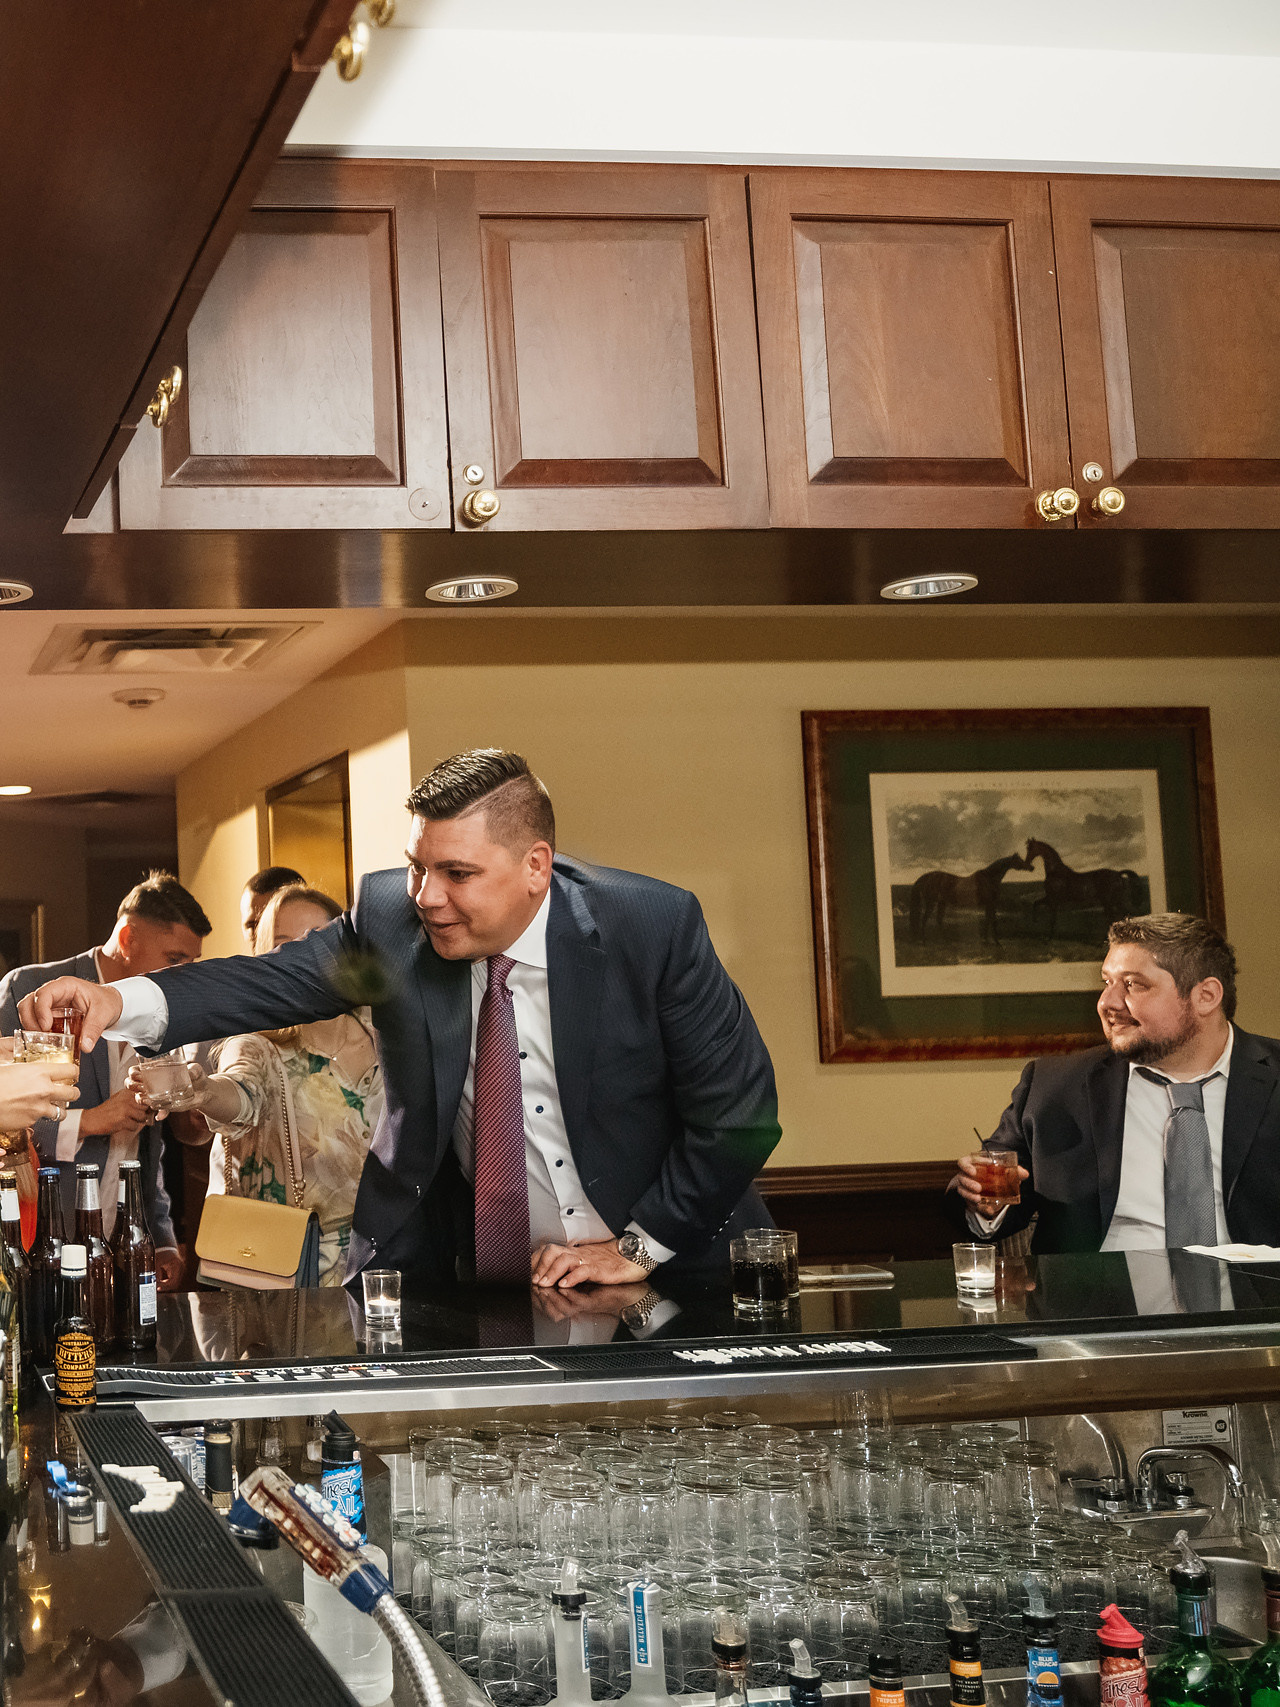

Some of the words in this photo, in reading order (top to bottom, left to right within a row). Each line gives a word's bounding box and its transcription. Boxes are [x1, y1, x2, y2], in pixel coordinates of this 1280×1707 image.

[59, 1347, 93, 1361] BITTERS
[636, 1605, 645, 1643] BELVEDERE
[1101, 1675, 1145, 1701] Finest
[875, 1696, 898, 1704] TRIPLE
